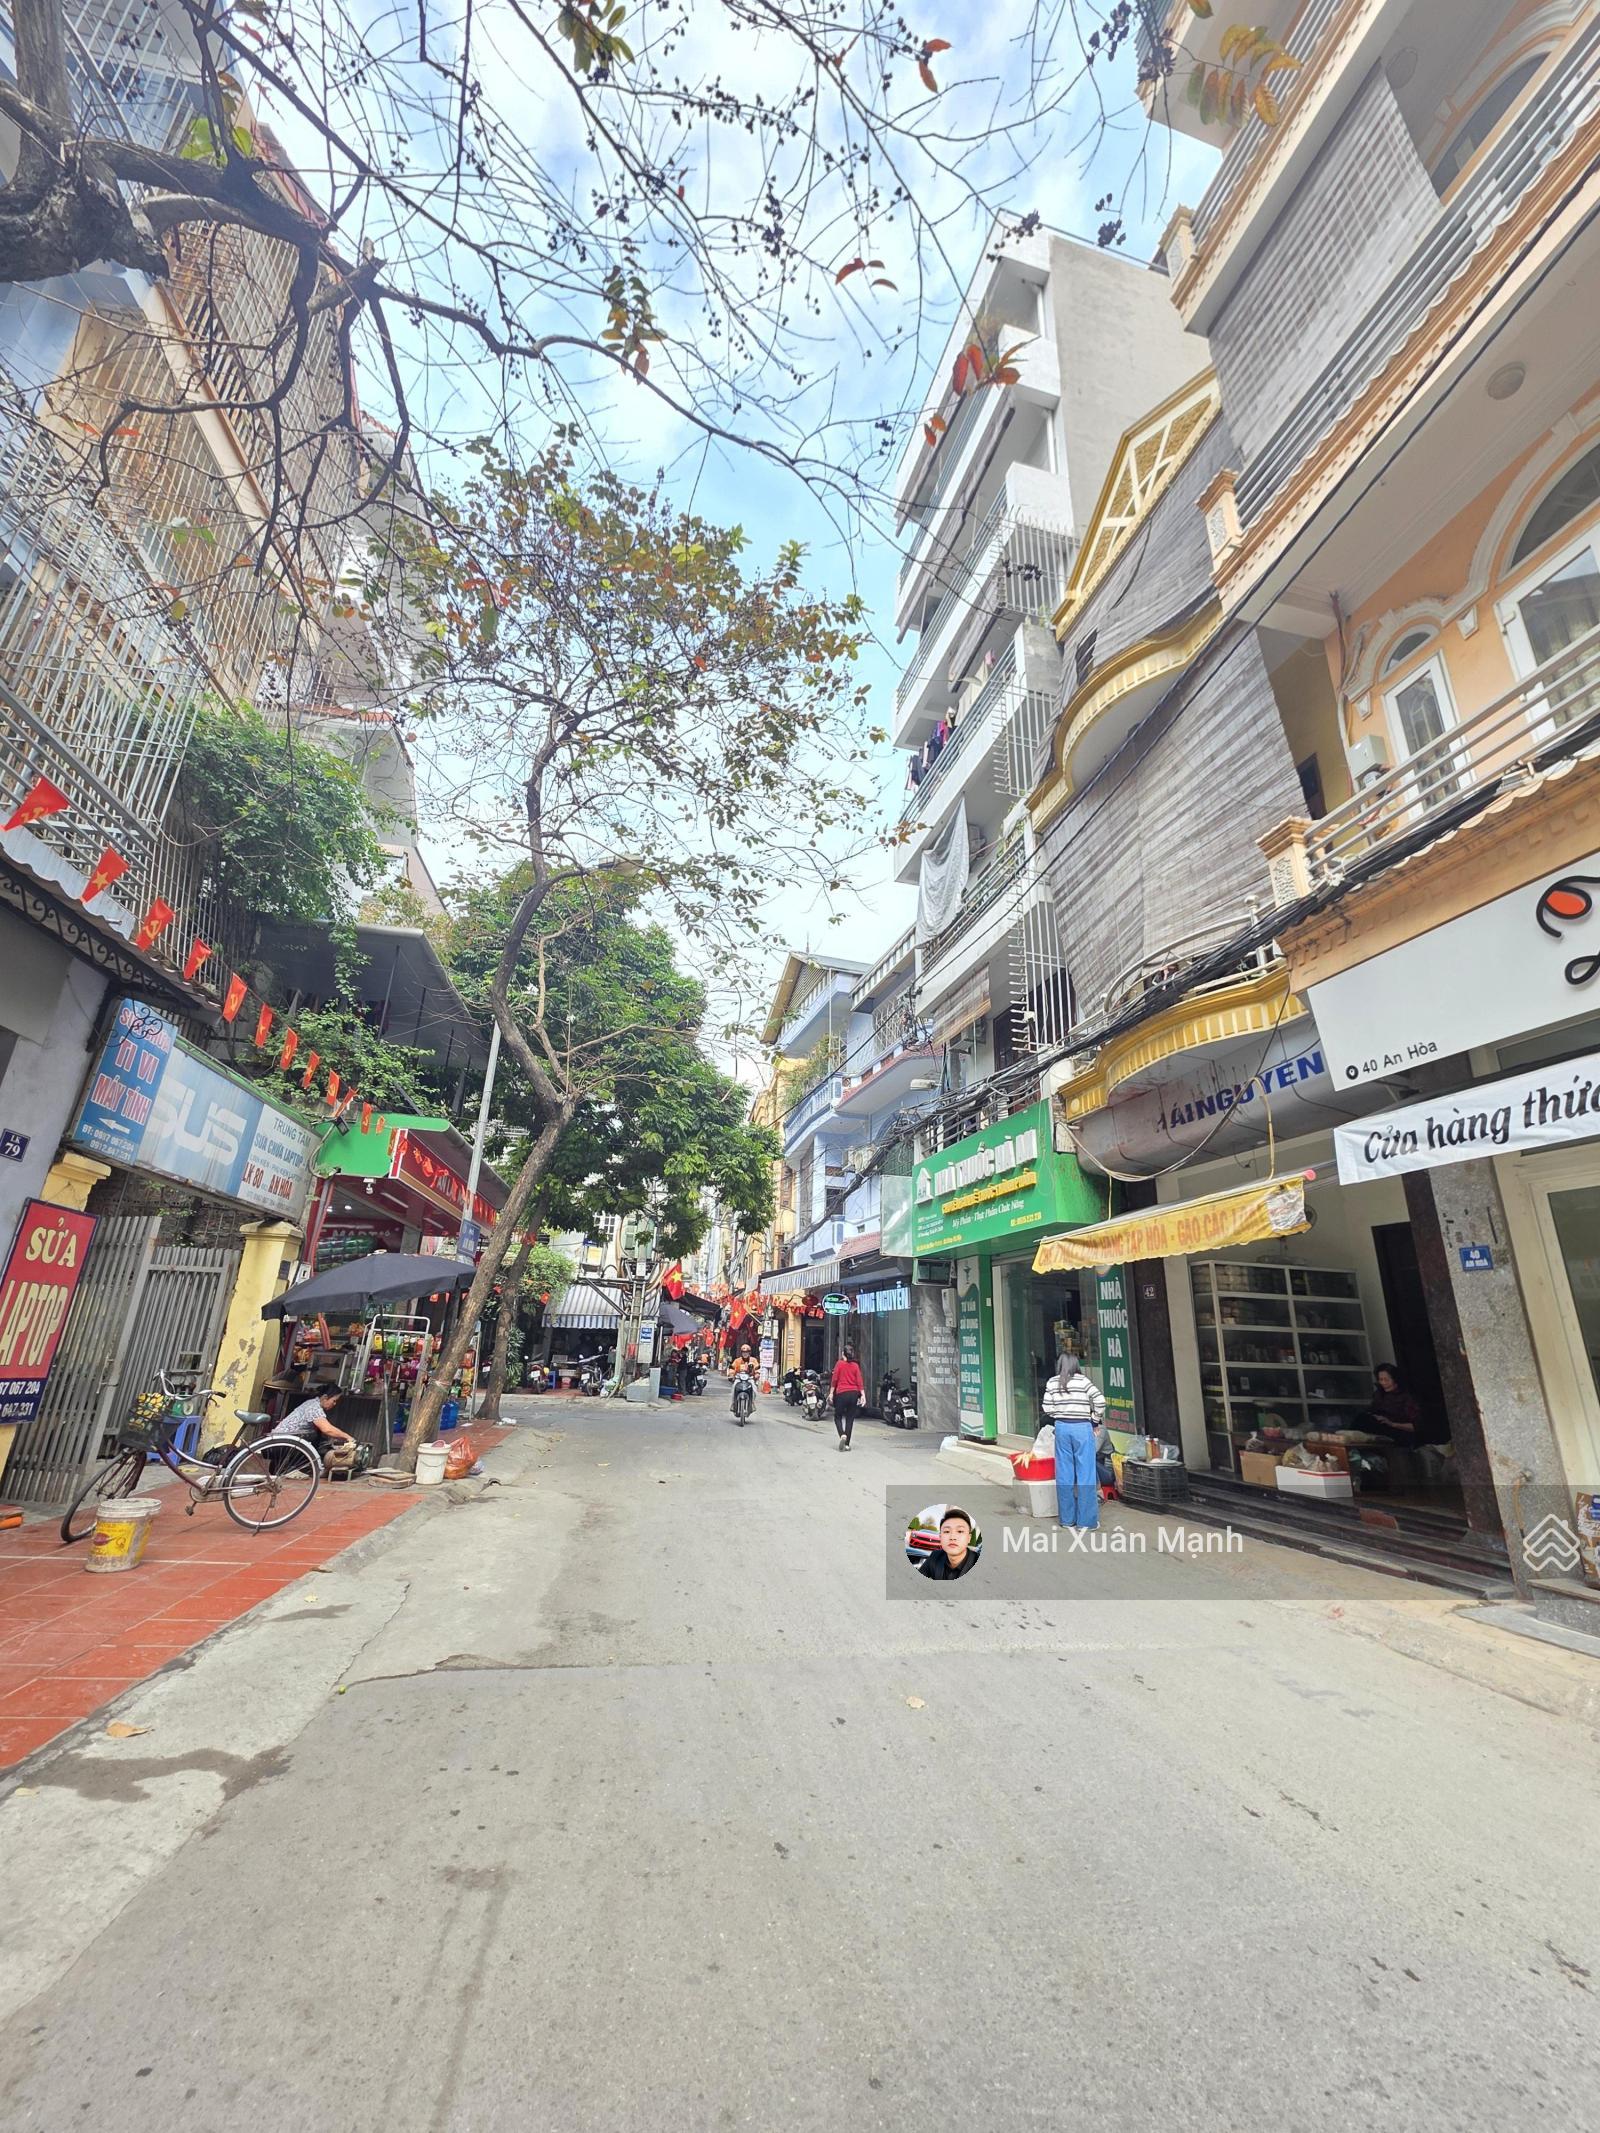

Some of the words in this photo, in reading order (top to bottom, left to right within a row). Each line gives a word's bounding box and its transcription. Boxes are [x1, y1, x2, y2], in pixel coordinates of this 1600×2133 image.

[115, 1036, 138, 1072] TI
[137, 1049, 160, 1084] VI
[1362, 1059, 1378, 1074] 40
[1383, 1052, 1403, 1068] An
[1407, 1040, 1438, 1060] Hòa
[91, 1074, 127, 1112] MÁY
[121, 1086, 153, 1126] TÍNH
[273, 1117, 297, 1141] TRUNG
[1364, 1124, 1419, 1163] Cửa
[1425, 1106, 1512, 1150] hàng
[5, 1142, 21, 1157] 79
[26, 1217, 76, 1267] SỬA
[1100, 1276, 1123, 1300] NHÀ
[1098, 1303, 1128, 1329] THUỐC
[1107, 1334, 1123, 1358] HÀ
[1109, 1367, 1125, 1388] AN
